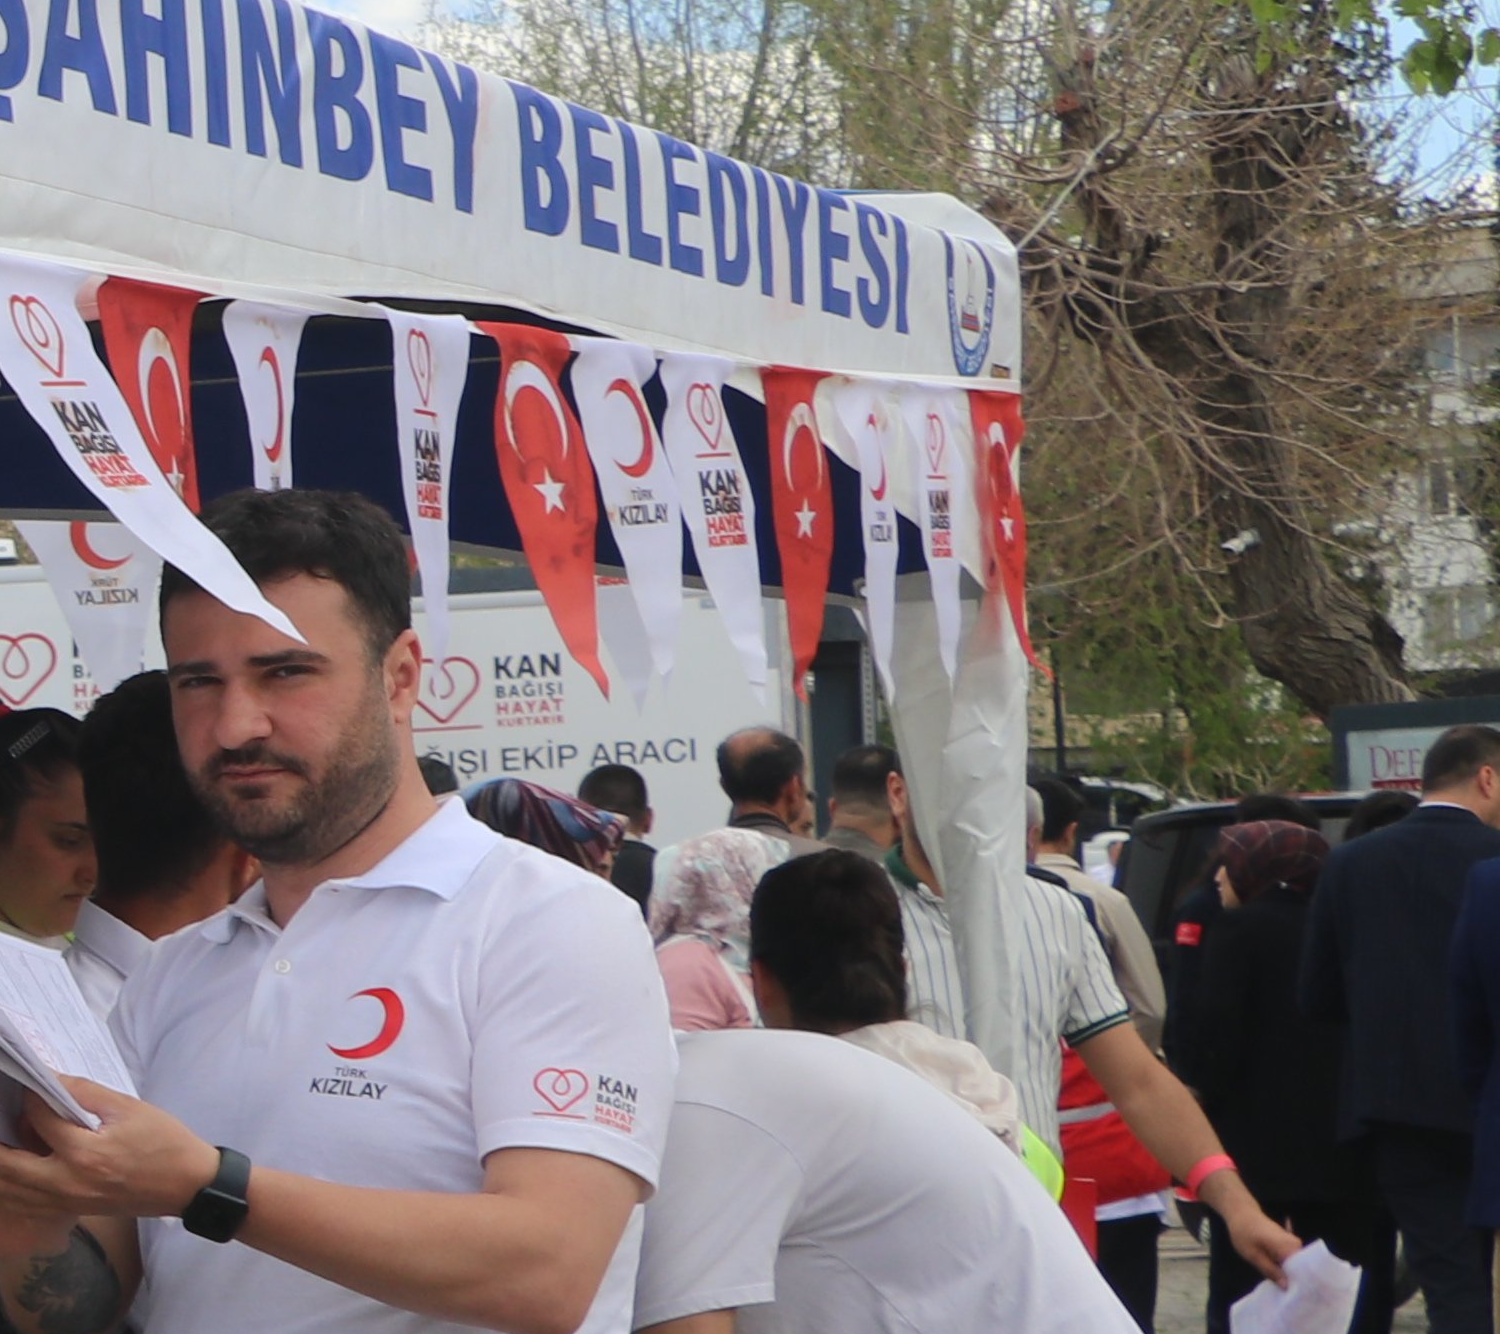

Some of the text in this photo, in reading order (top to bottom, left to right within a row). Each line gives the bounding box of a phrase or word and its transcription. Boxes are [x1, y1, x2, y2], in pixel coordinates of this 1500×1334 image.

[51, 400, 110, 434] KAN
[414, 428, 441, 461] KAN
[83, 454, 135, 475] HAYAT
[697, 468, 739, 497] KAN
[618, 503, 669, 527] KIZILAY
[706, 513, 746, 535] HAYAT
[493, 652, 562, 680] KAN
[494, 680, 564, 700] BAĞIŞI
[495, 698, 565, 716] HAYAT
[496, 715, 565, 728] KURTARIR
[501, 739, 578, 772] EKİP
[590, 737, 698, 768] ARACI
[335, 1066, 367, 1080] TÜRK
[308, 1077, 389, 1101] KIZILAY
[597, 1073, 639, 1103] KAN
[594, 1104, 636, 1126] HAYAT
